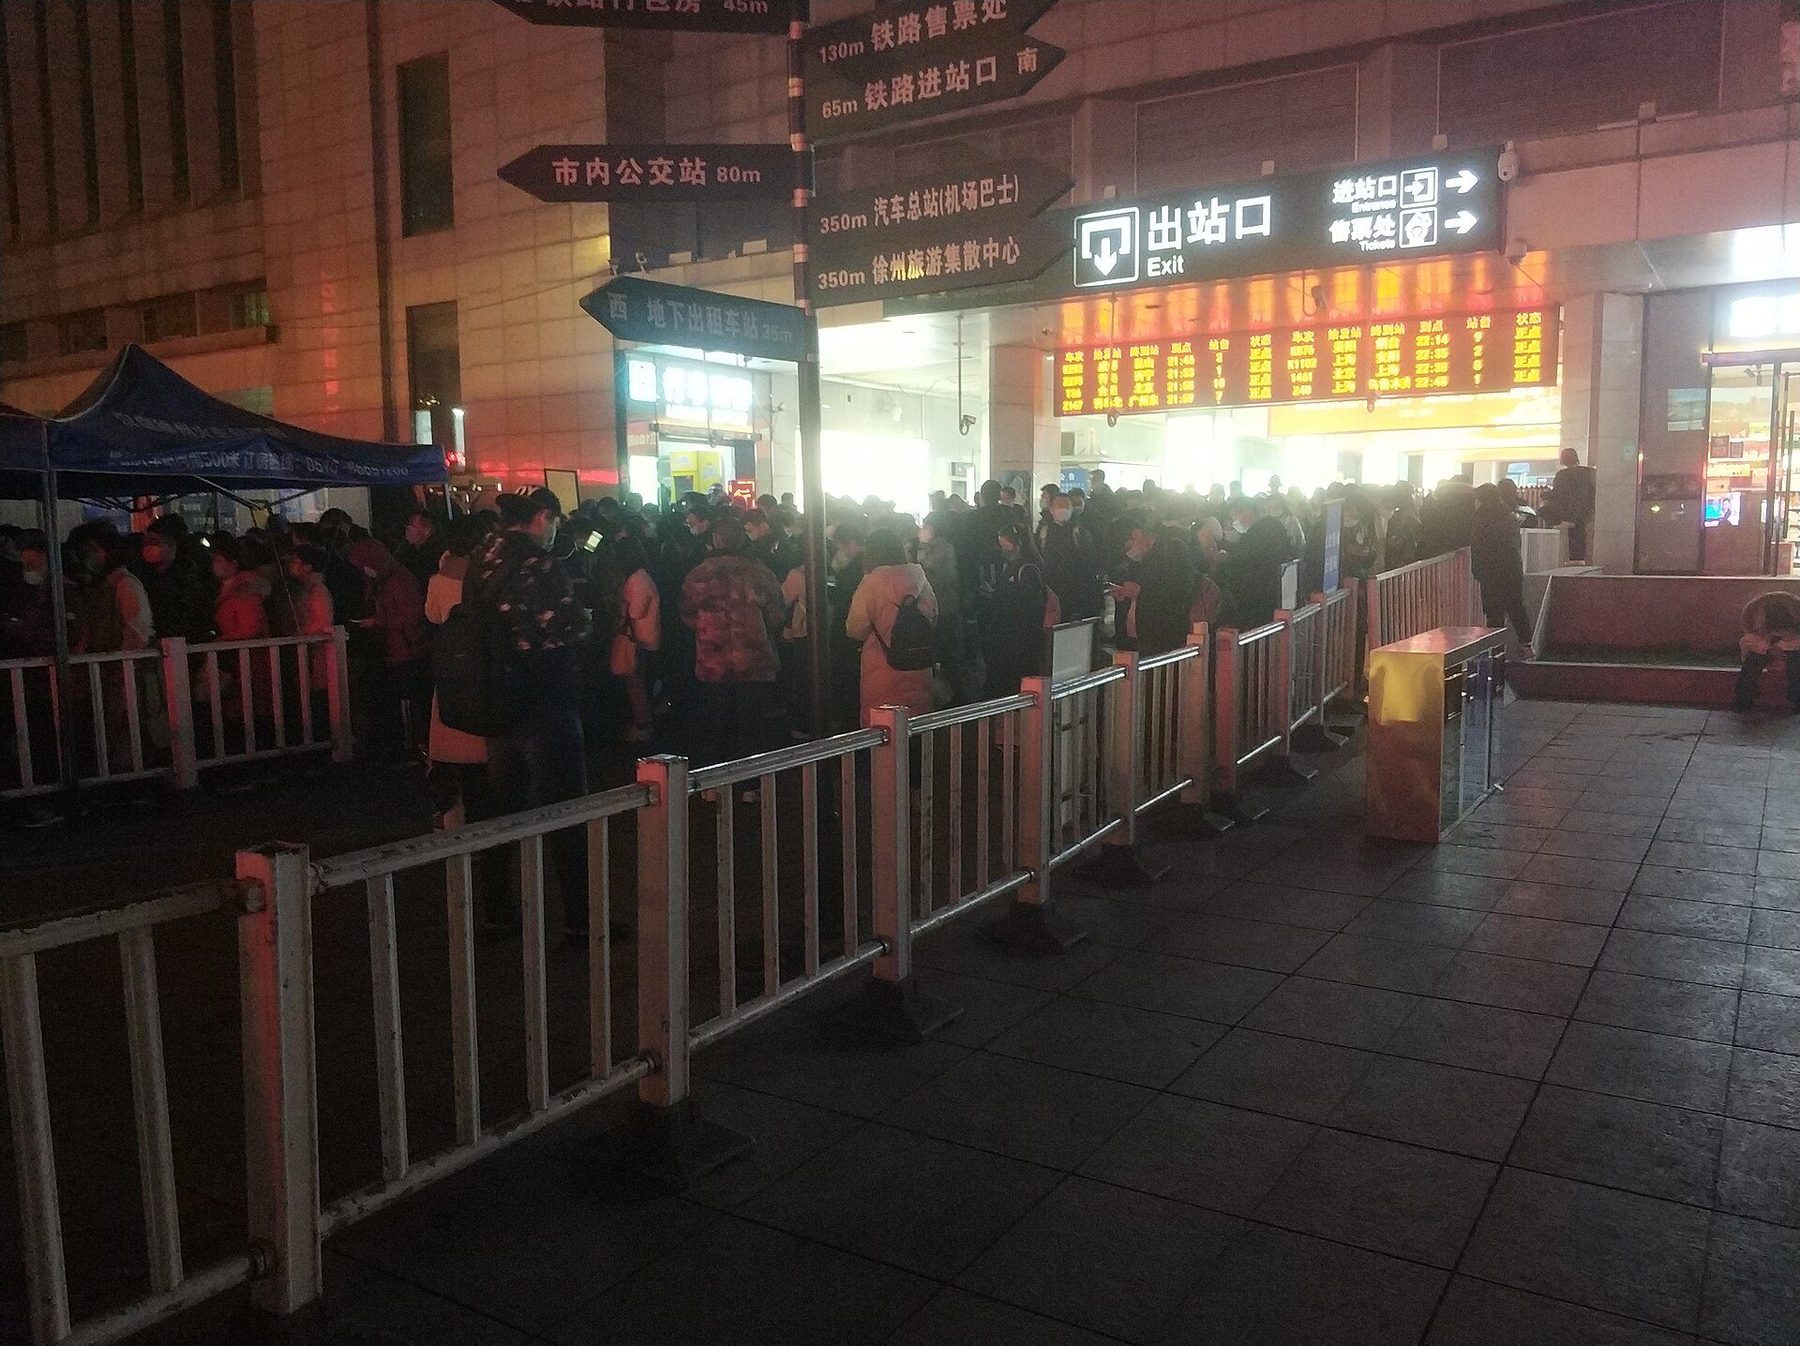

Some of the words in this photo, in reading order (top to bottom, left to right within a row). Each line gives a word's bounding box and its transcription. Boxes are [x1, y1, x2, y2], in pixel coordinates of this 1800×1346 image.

[819, 41, 864, 63] 130m
[871, 0, 1007, 52] 铁路售票处
[822, 98, 858, 120] 65m
[864, 56, 997, 111] 铁路进站口
[1017, 47, 1039, 74] 南
[552, 157, 706, 186] 市内公交站
[716, 166, 761, 184] 80m
[1332, 175, 1397, 204] 进站口
[820, 213, 867, 234] 350m
[874, 174, 1019, 227] 汽车总站(机场巴士)
[1148, 194, 1271, 252] 出站口
[1328, 213, 1396, 244] 售票处
[818, 269, 865, 290] 350m
[872, 235, 1020, 285] 徐州旅游集散中心
[1147, 254, 1184, 277] Exit
[607, 291, 628, 320] 西
[647, 296, 759, 339] 地下出租车站
